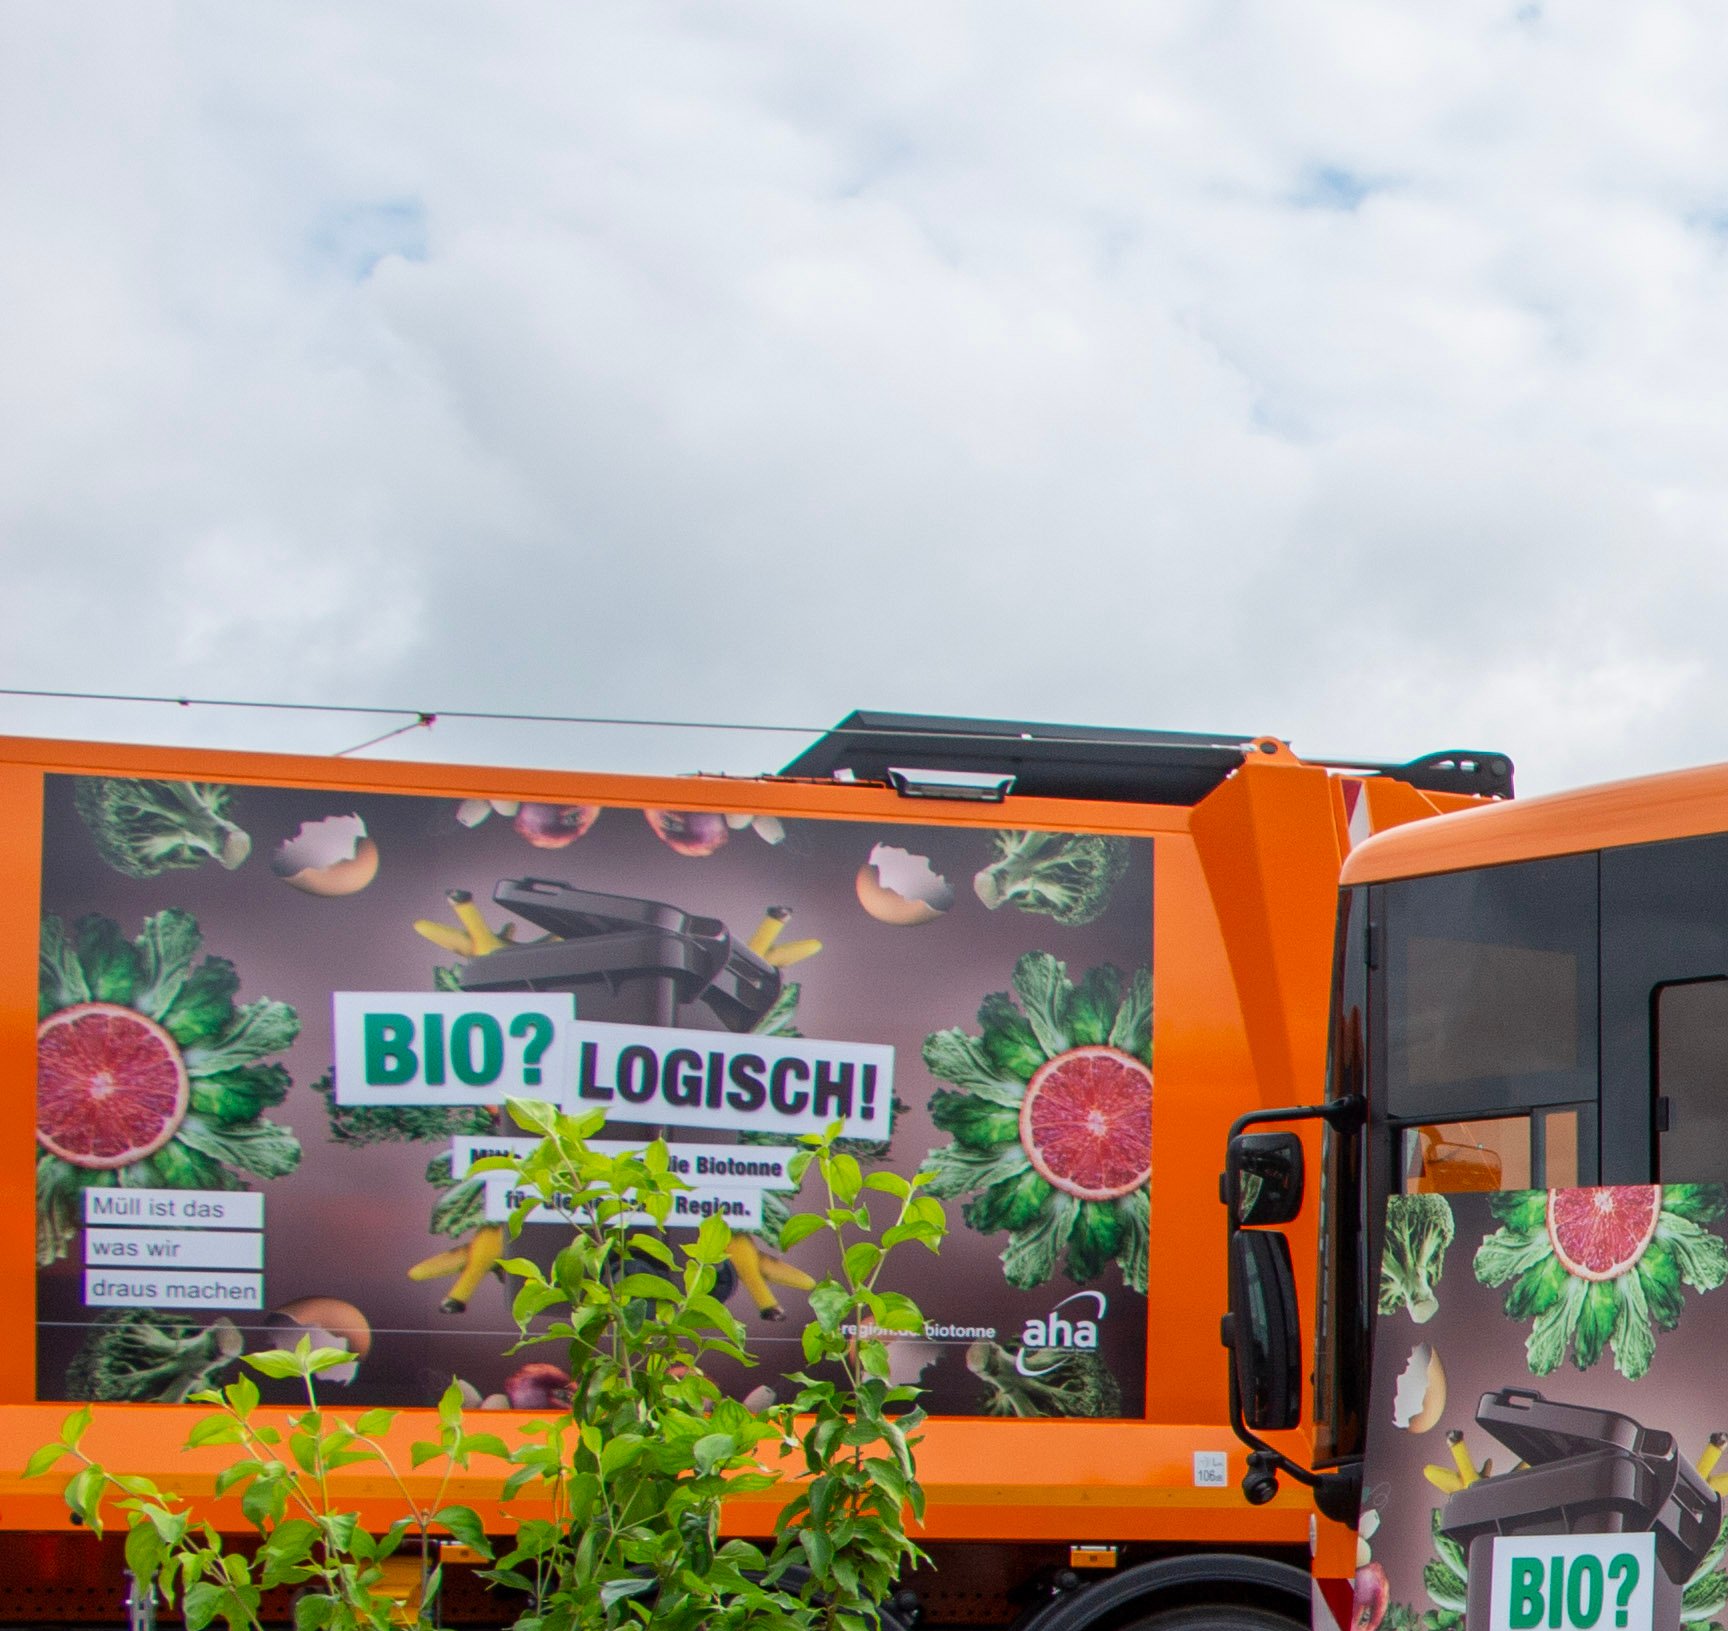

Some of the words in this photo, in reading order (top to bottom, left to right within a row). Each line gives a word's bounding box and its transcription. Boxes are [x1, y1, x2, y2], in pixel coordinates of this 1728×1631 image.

[363, 1011, 555, 1088] BIO?
[578, 1042, 879, 1120] LOGISCH!
[696, 1157, 782, 1177] Biotonne
[94, 1196, 141, 1220] Müll
[147, 1198, 176, 1220] ist
[182, 1198, 224, 1220] das
[676, 1197, 751, 1218] Region.
[94, 1240, 139, 1261] was
[146, 1239, 181, 1261] wir
[92, 1277, 158, 1302] draus
[165, 1280, 257, 1303] machen
[1023, 1312, 1097, 1348] aha
[1509, 1552, 1641, 1630] BIO?
